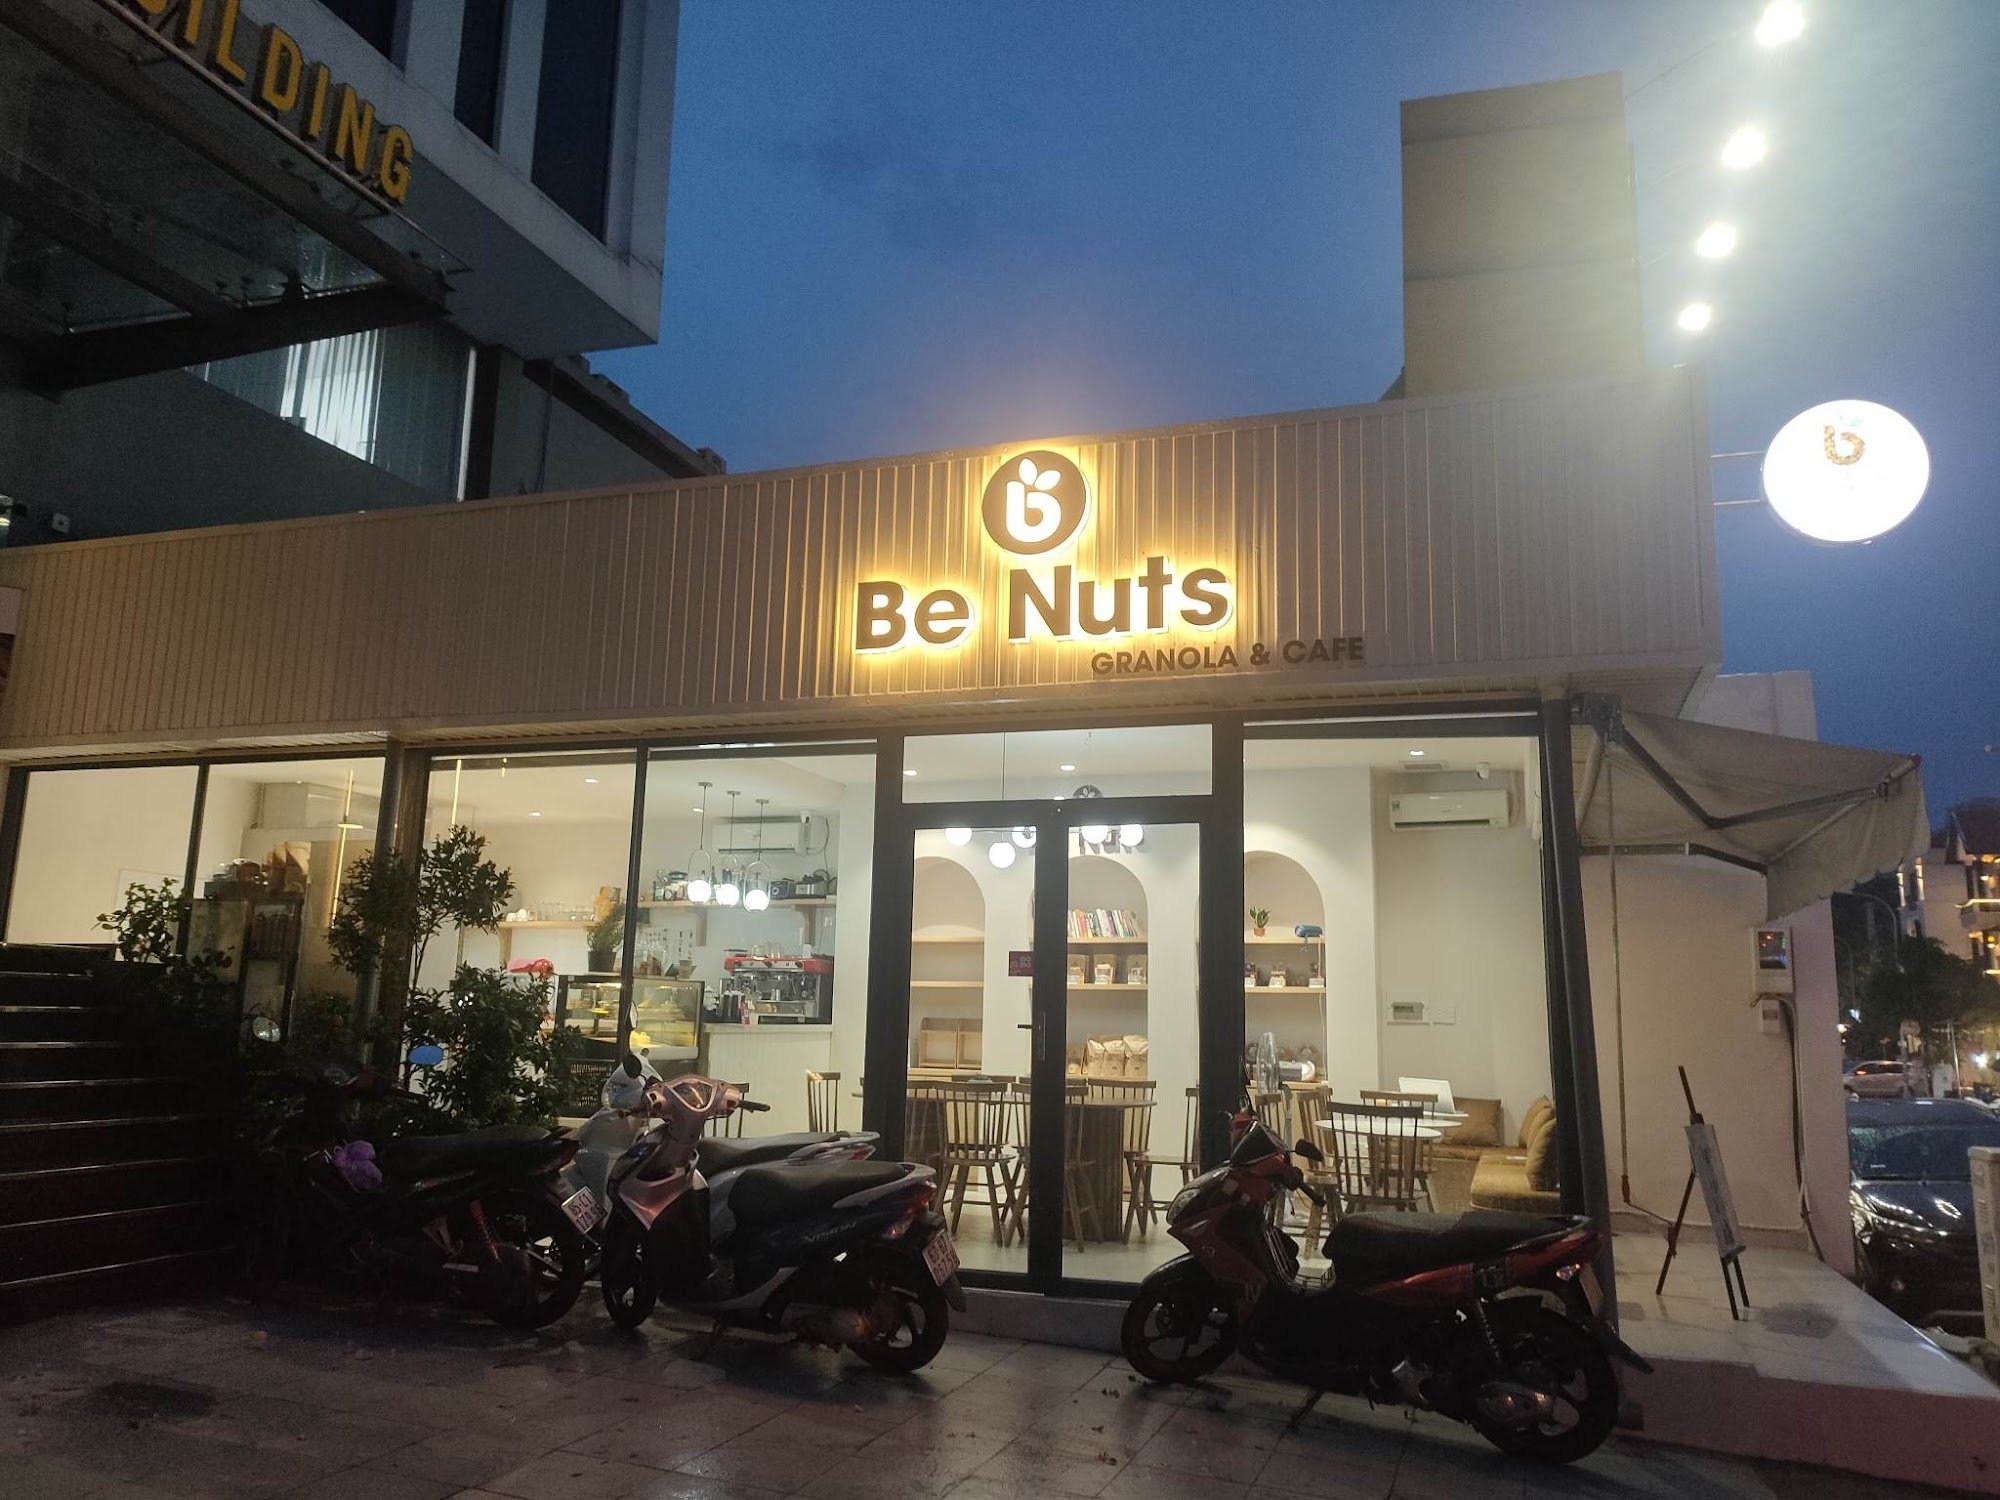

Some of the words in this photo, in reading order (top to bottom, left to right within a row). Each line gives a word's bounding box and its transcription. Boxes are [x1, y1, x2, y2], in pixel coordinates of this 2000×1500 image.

[135, 0, 412, 204] ILDING
[856, 581, 970, 650] Be
[1008, 556, 1230, 640] Nuts
[1091, 645, 1239, 675] GRANOLA
[1250, 643, 1271, 665] &
[1283, 636, 1364, 664] CAFE
